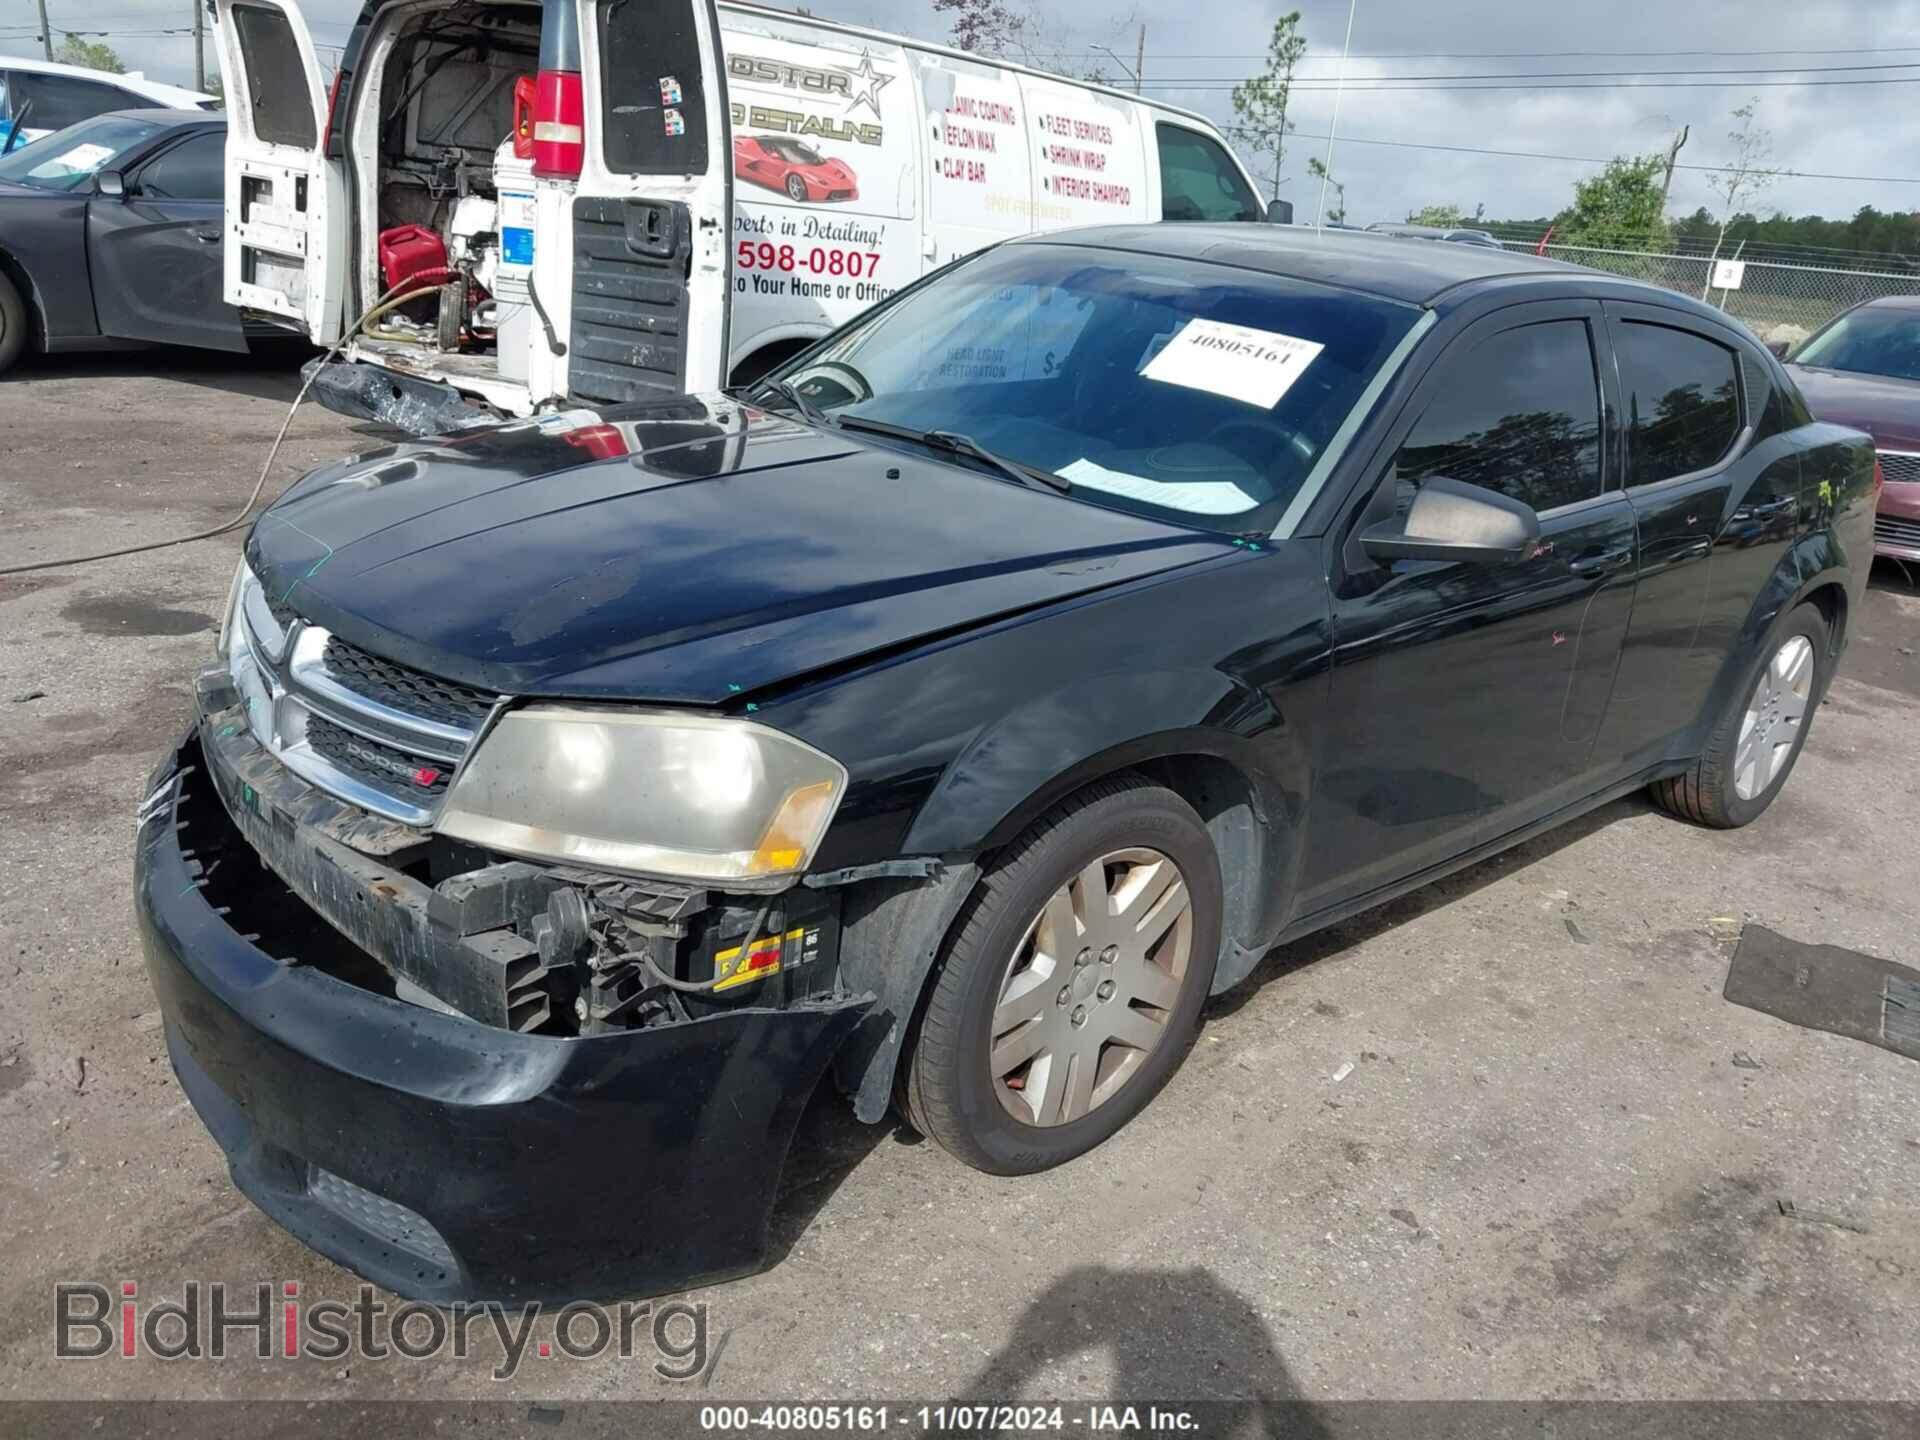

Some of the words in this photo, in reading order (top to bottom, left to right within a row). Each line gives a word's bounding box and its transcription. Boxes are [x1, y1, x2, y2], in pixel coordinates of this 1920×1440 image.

[979, 101, 1016, 125] COATING
[977, 131, 996, 153] WAX
[1046, 114, 1071, 137] FLEET
[1073, 120, 1112, 145] SERVICES
[944, 157, 964, 179] CLAY
[968, 161, 986, 183] BAR
[1050, 144, 1081, 168] SHRINK
[1083, 149, 1106, 172] WRAP
[1052, 175, 1091, 200] INTERIOR
[1092, 181, 1130, 206] SHAMPOO
[781, 216, 797, 236] in
[803, 215, 885, 251] Detailing!
[737, 240, 880, 278] 598-0807
[752, 274, 786, 295] Your
[791, 277, 832, 299] Home
[837, 286, 851, 300] or
[1189, 335, 1291, 364] 40805161
[938, 364, 1007, 379] RESTORATION
[347, 742, 418, 781] DODGE
[806, 934, 819, 946] 86
